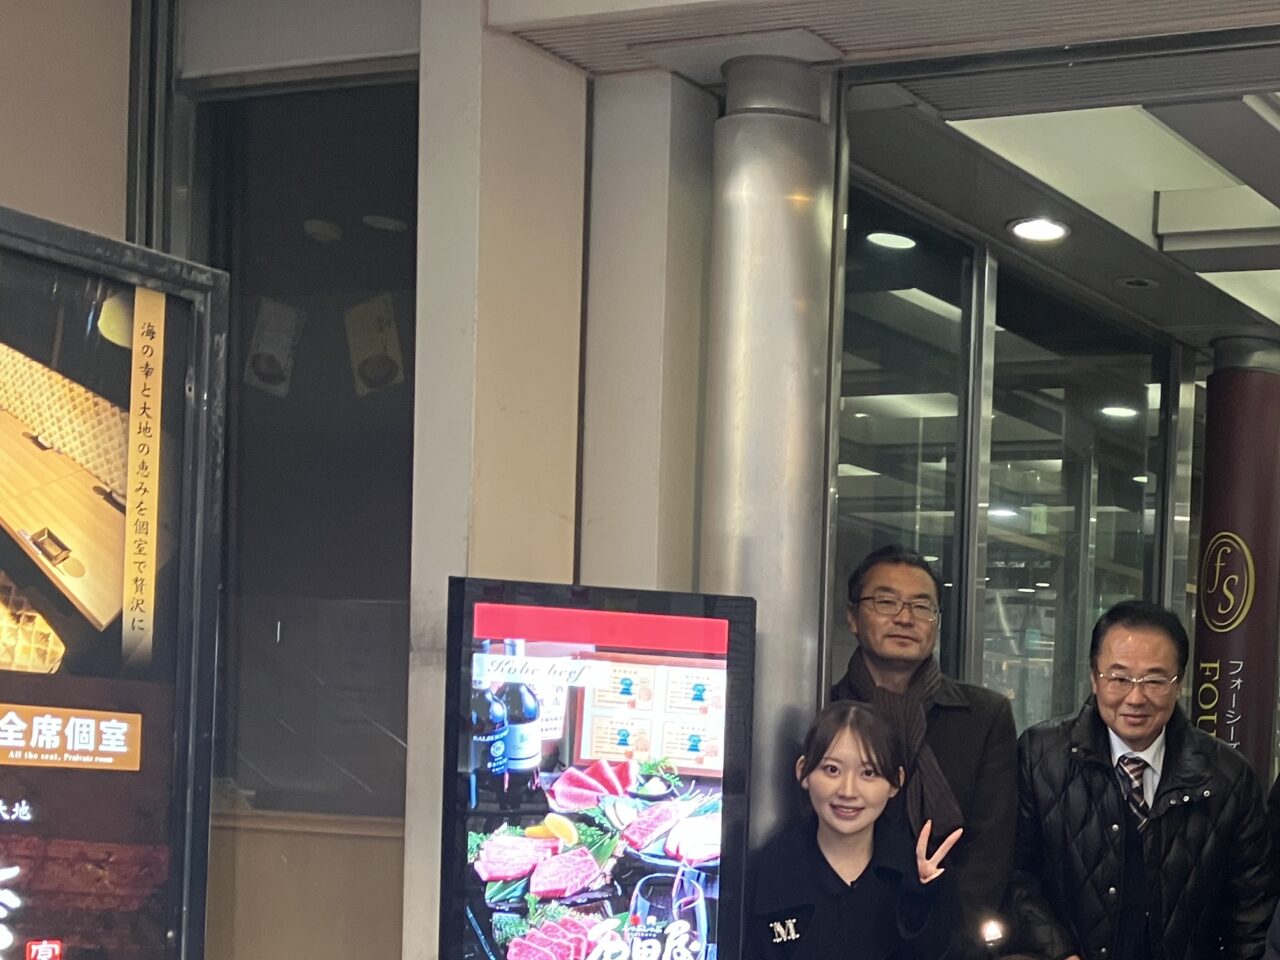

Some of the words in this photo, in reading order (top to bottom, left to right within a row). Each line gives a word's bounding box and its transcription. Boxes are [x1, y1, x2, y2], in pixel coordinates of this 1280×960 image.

[130, 321, 156, 631] 海の幸と大地の恵みを個室で贅沢に
[0, 711, 128, 752] 全席個室
[8, 750, 22, 759] All
[24, 751, 38, 760] the
[769, 918, 800, 943] M
